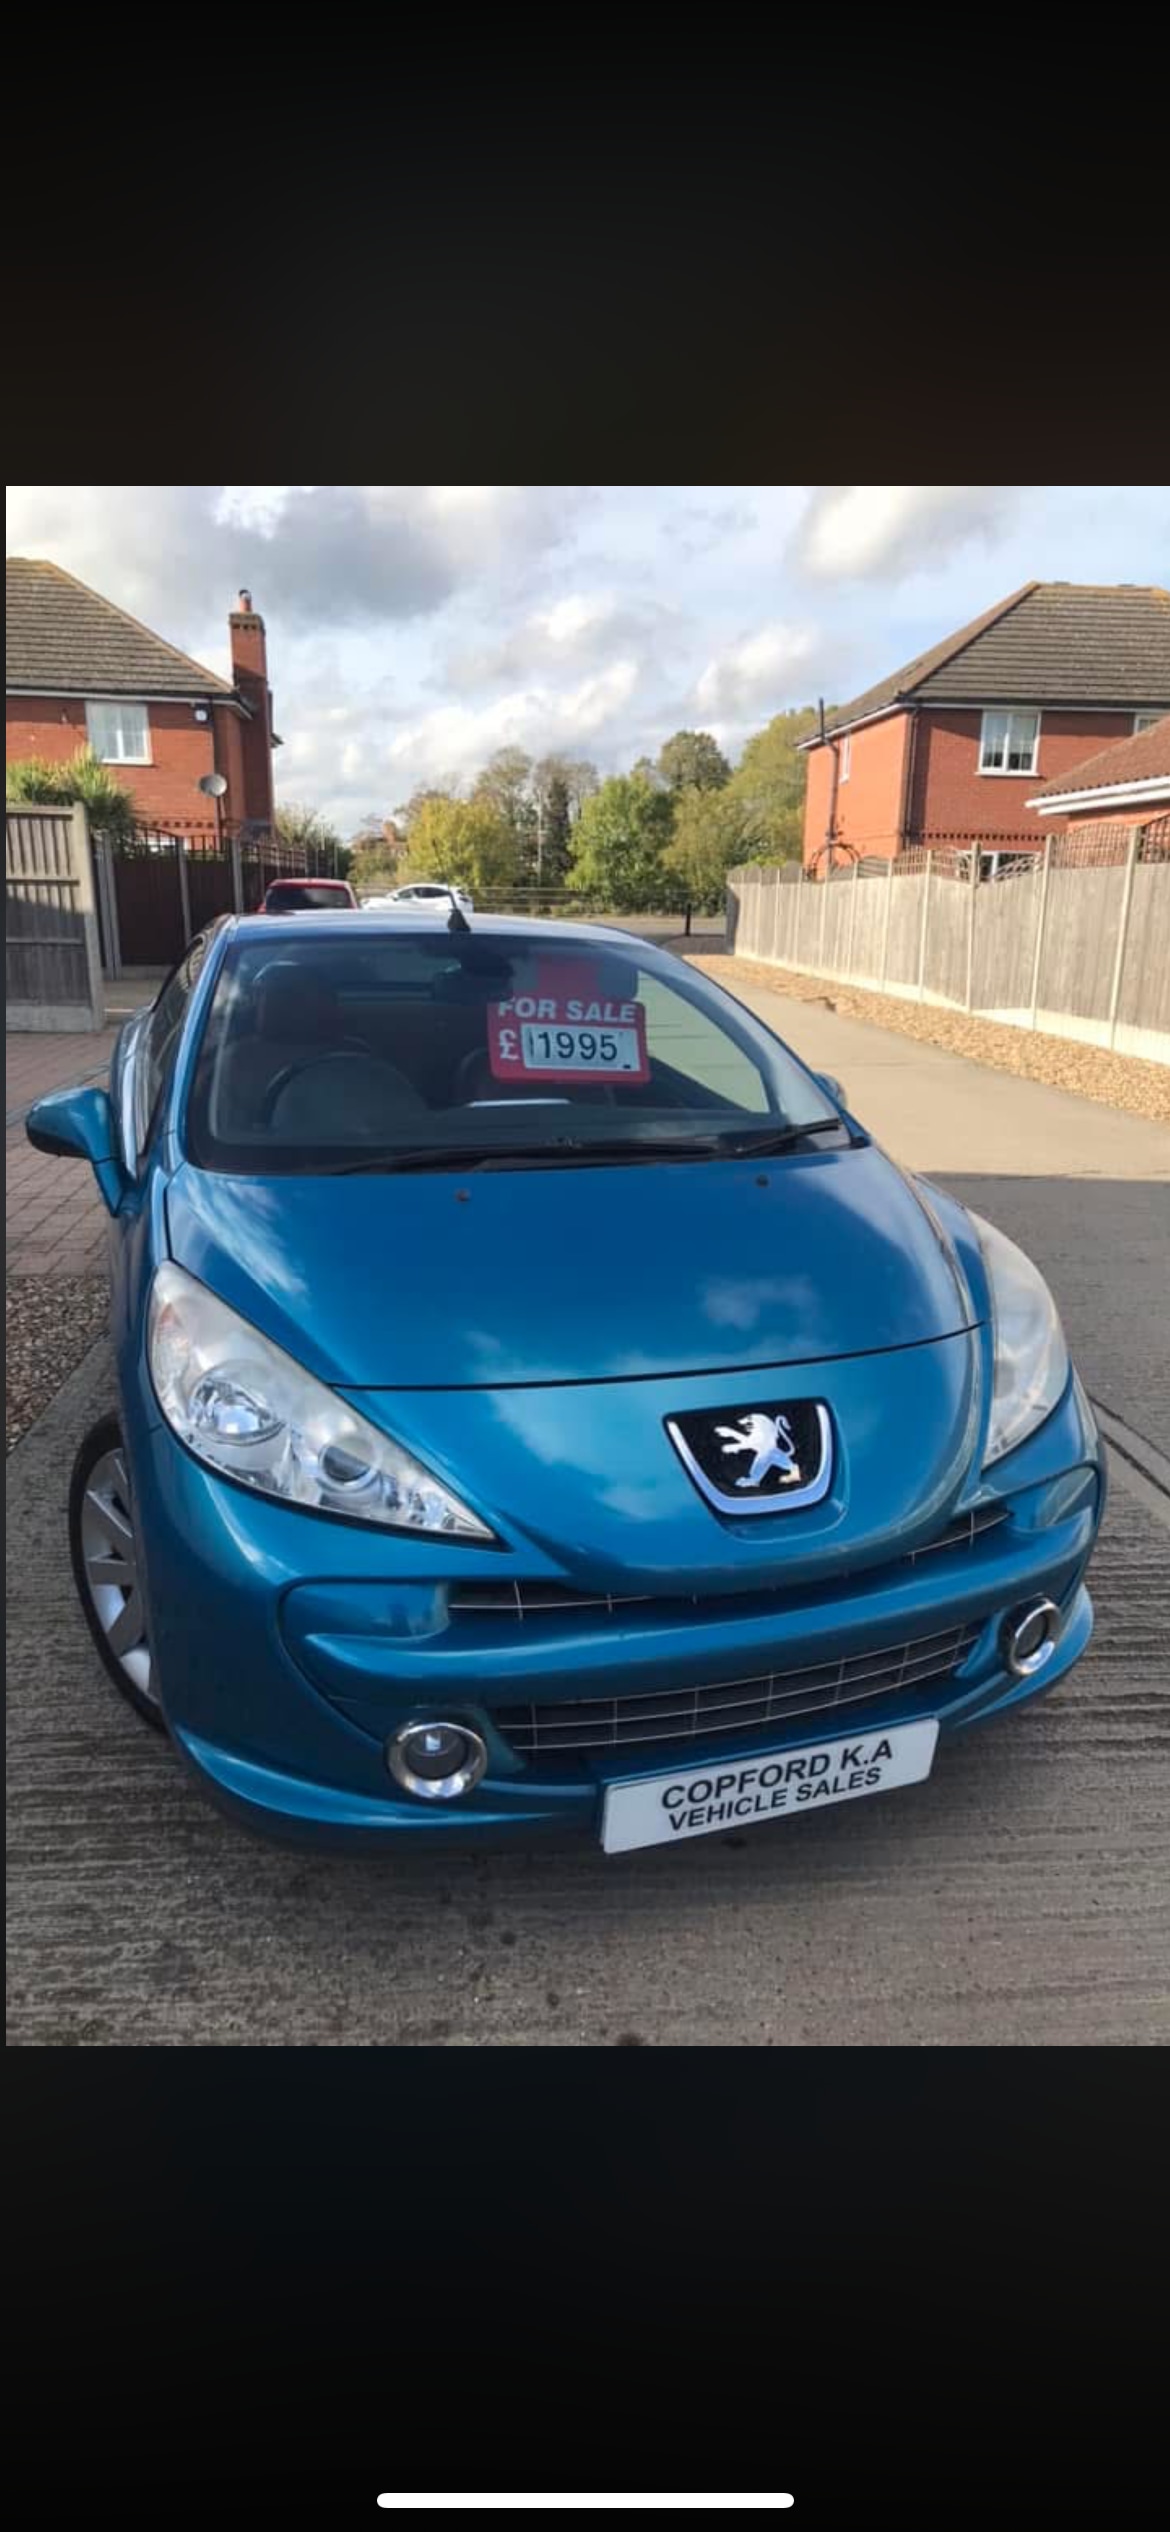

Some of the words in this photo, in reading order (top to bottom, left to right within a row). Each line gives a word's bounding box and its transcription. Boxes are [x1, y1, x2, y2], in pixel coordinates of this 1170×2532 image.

[498, 997, 557, 1019] FOR
[566, 1000, 637, 1023] SALE
[661, 1753, 831, 1809] COPFORD
[839, 1739, 893, 1771] K.A
[669, 1788, 787, 1831] VEHICLE
[795, 1766, 881, 1802] SALES
